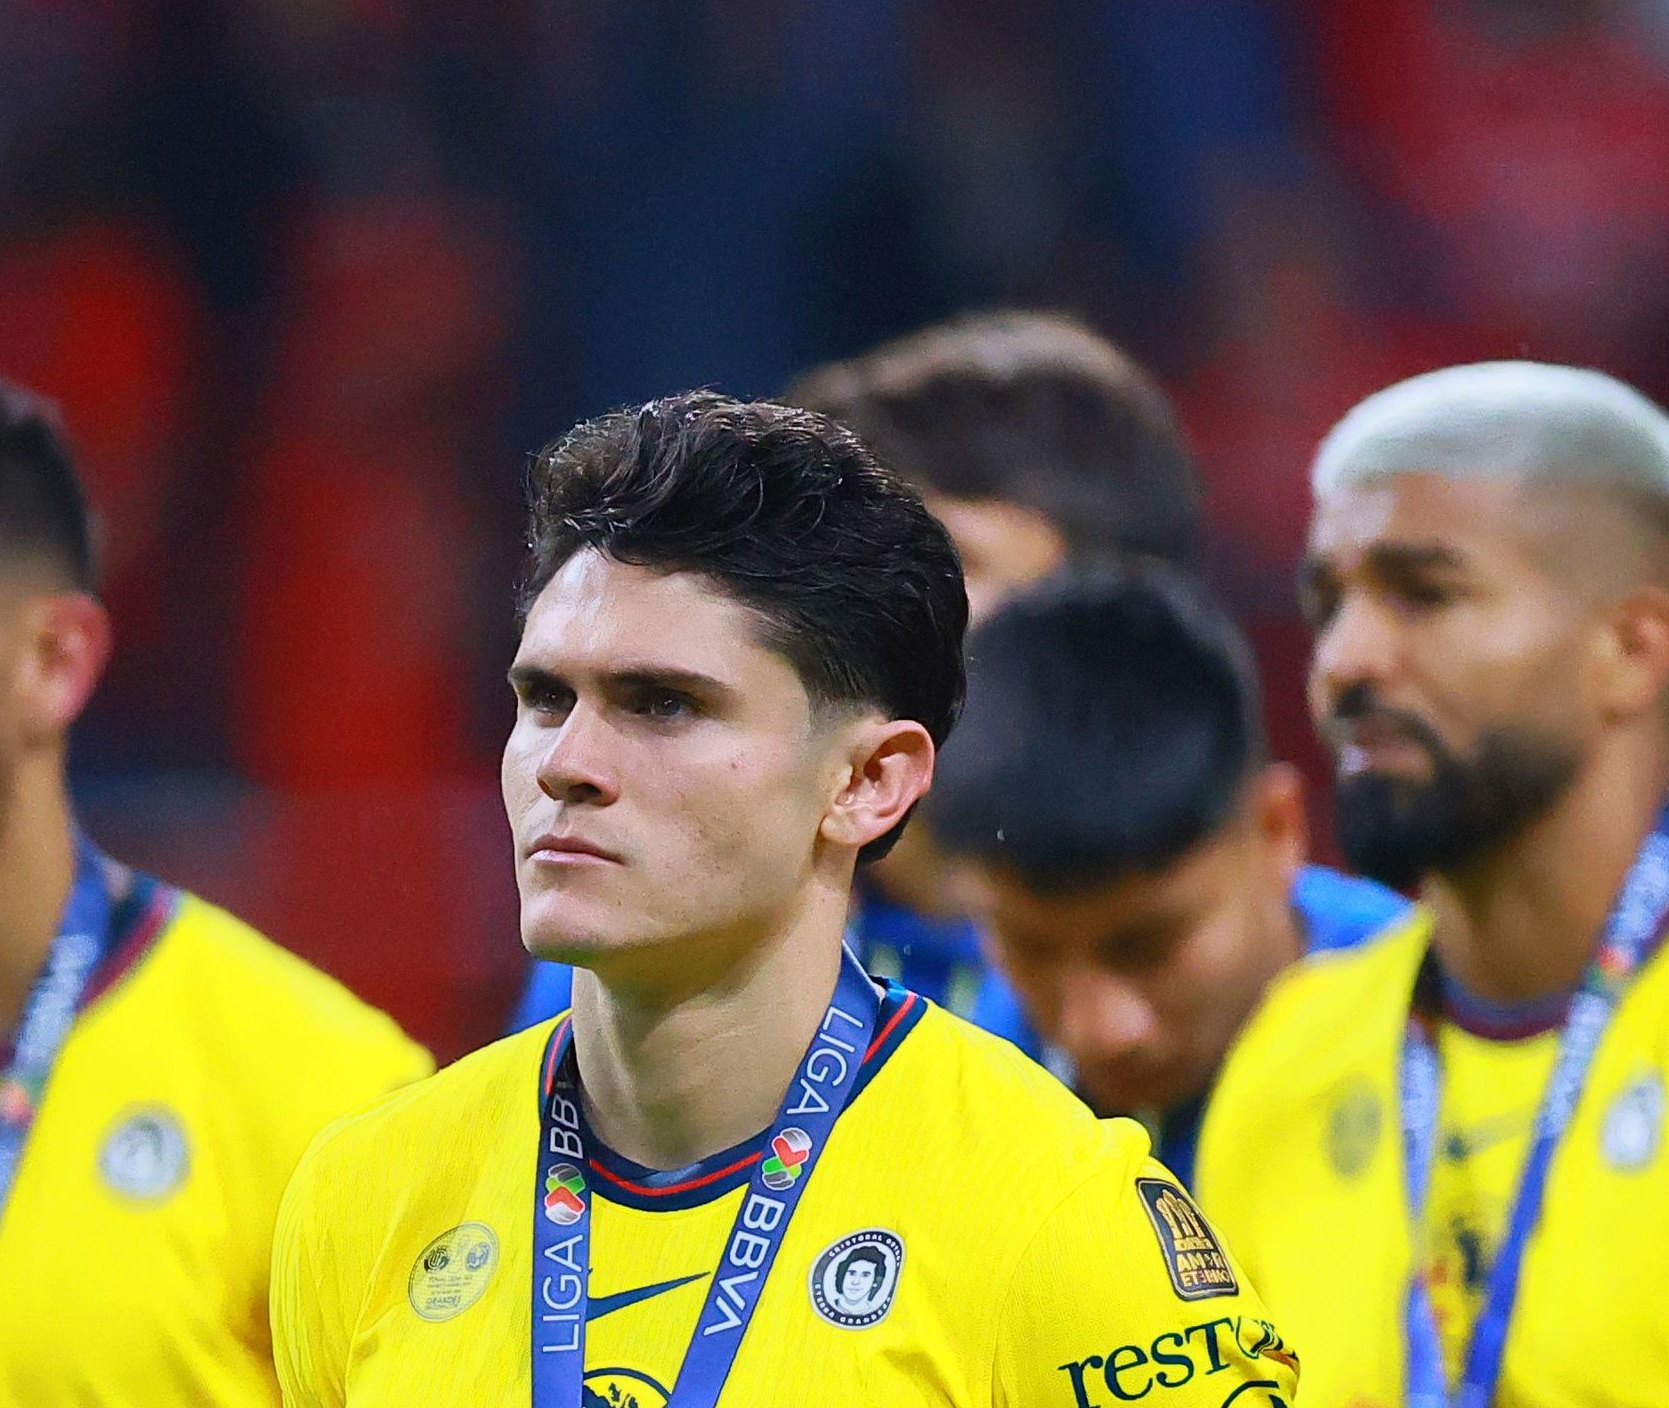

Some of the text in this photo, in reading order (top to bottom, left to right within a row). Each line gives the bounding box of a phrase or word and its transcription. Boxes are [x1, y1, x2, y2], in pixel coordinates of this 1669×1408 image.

[787, 1005, 864, 1116] LIGA
[542, 1234, 583, 1353] LIGA
[702, 1192, 787, 1338] BBVA
